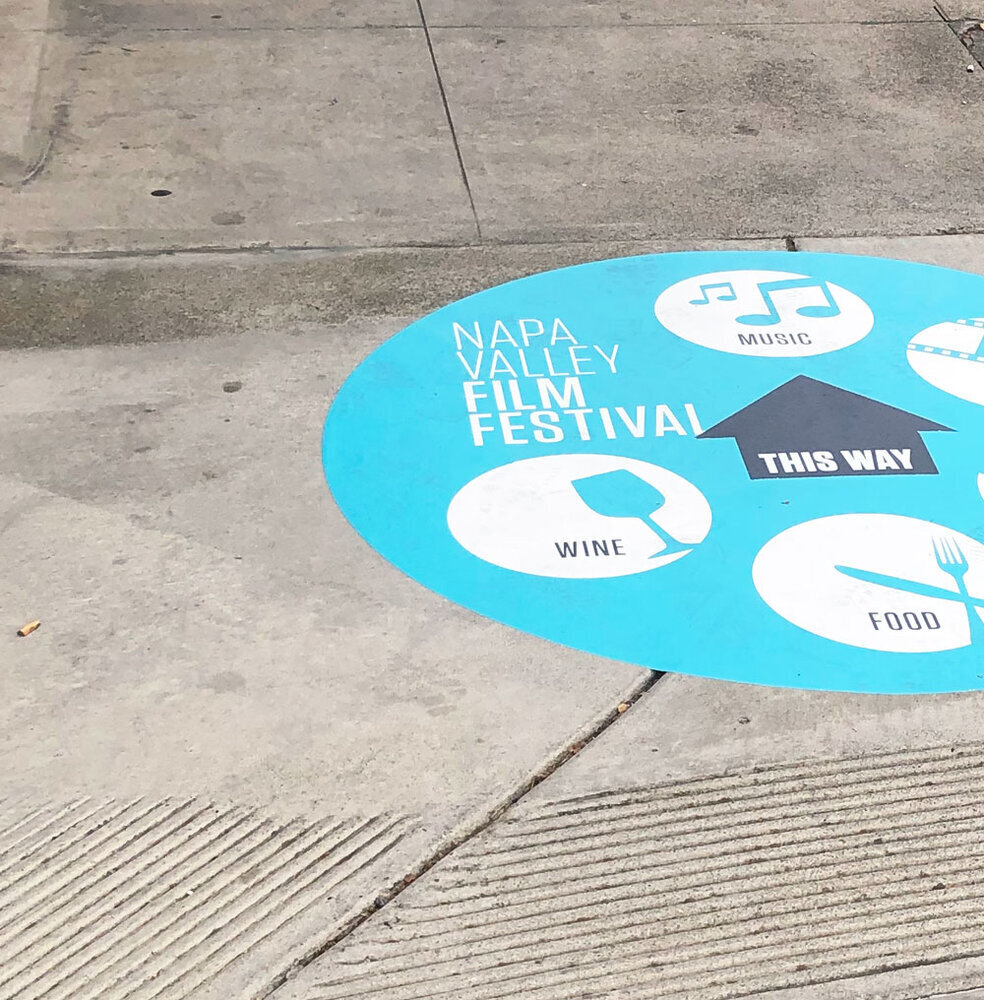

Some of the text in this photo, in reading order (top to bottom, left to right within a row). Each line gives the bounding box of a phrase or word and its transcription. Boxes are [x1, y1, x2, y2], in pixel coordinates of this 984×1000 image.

[453, 318, 579, 350] NAPA
[737, 332, 813, 346] MUSIC
[456, 344, 620, 380] VALLEY
[463, 376, 587, 413] FILM
[469, 403, 705, 447] FESTIVAL
[757, 448, 914, 474] THIS WAY
[554, 538, 627, 559] WINE
[868, 611, 941, 631] FOOD
